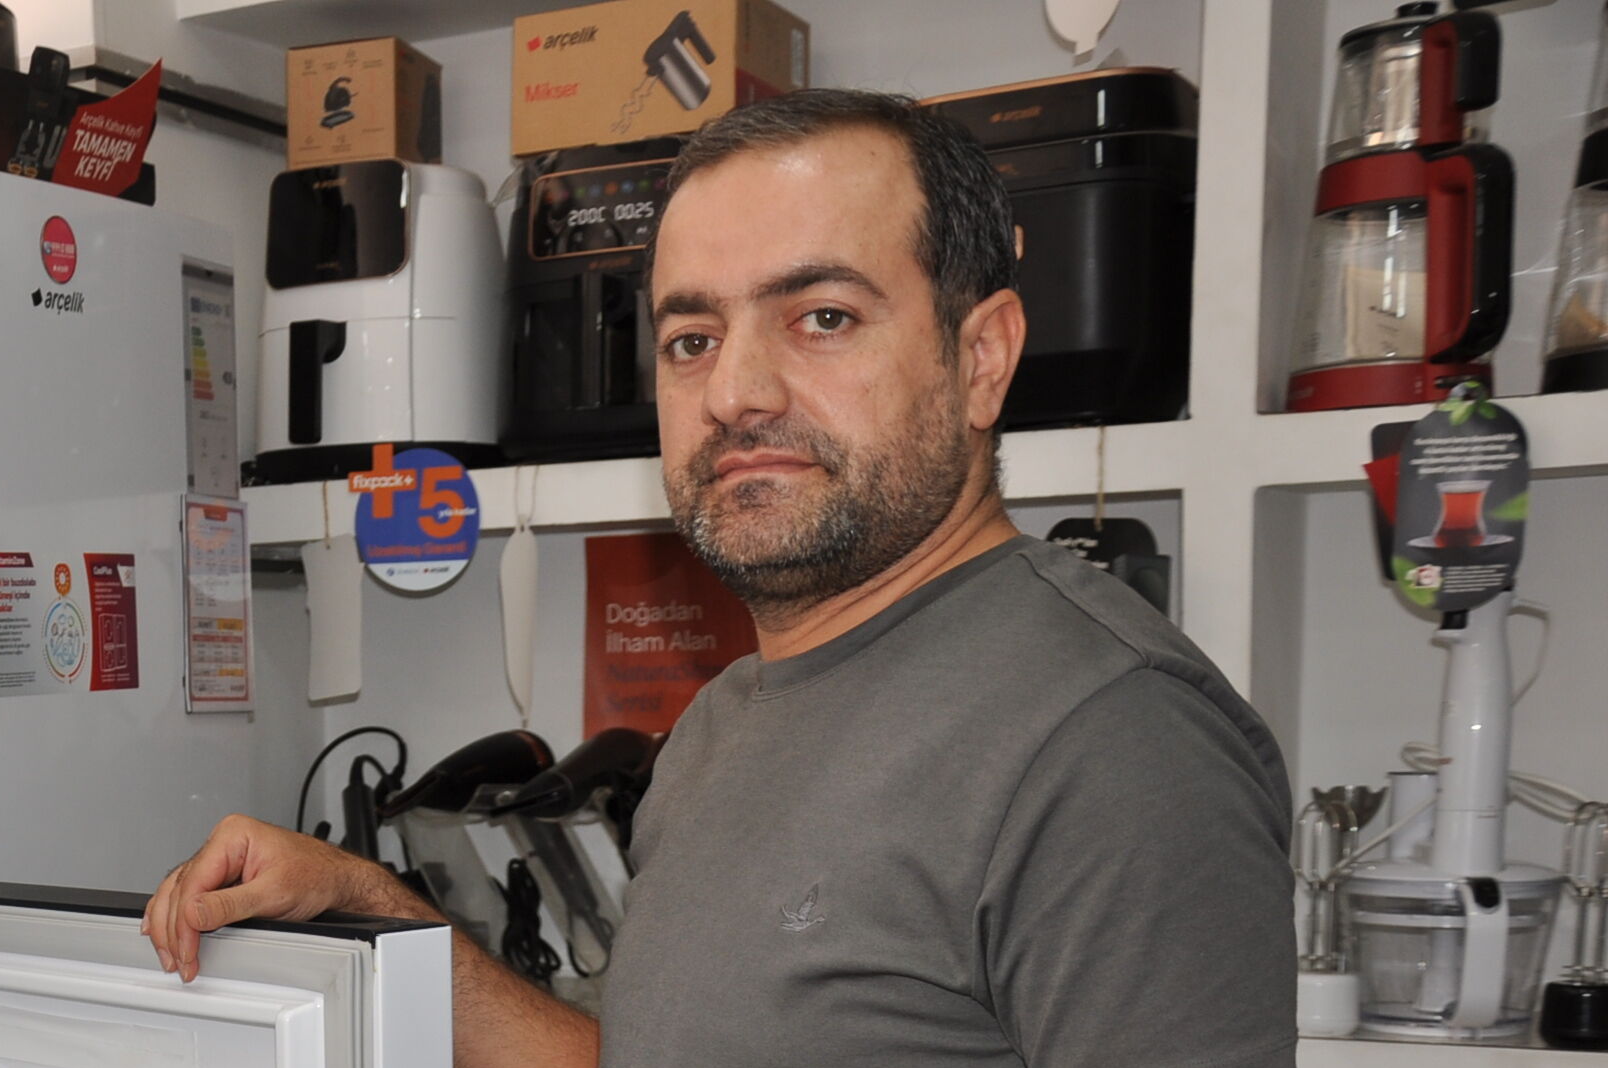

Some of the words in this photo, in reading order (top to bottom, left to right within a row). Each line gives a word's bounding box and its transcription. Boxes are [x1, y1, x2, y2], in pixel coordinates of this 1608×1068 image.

[543, 25, 599, 51] arçelik
[525, 82, 579, 103] Mikser
[73, 129, 136, 163] TAMAMEN
[614, 201, 654, 221] 0025
[44, 291, 84, 315] arçelik
[605, 600, 703, 627] Doğadan
[667, 630, 717, 652] Alan
